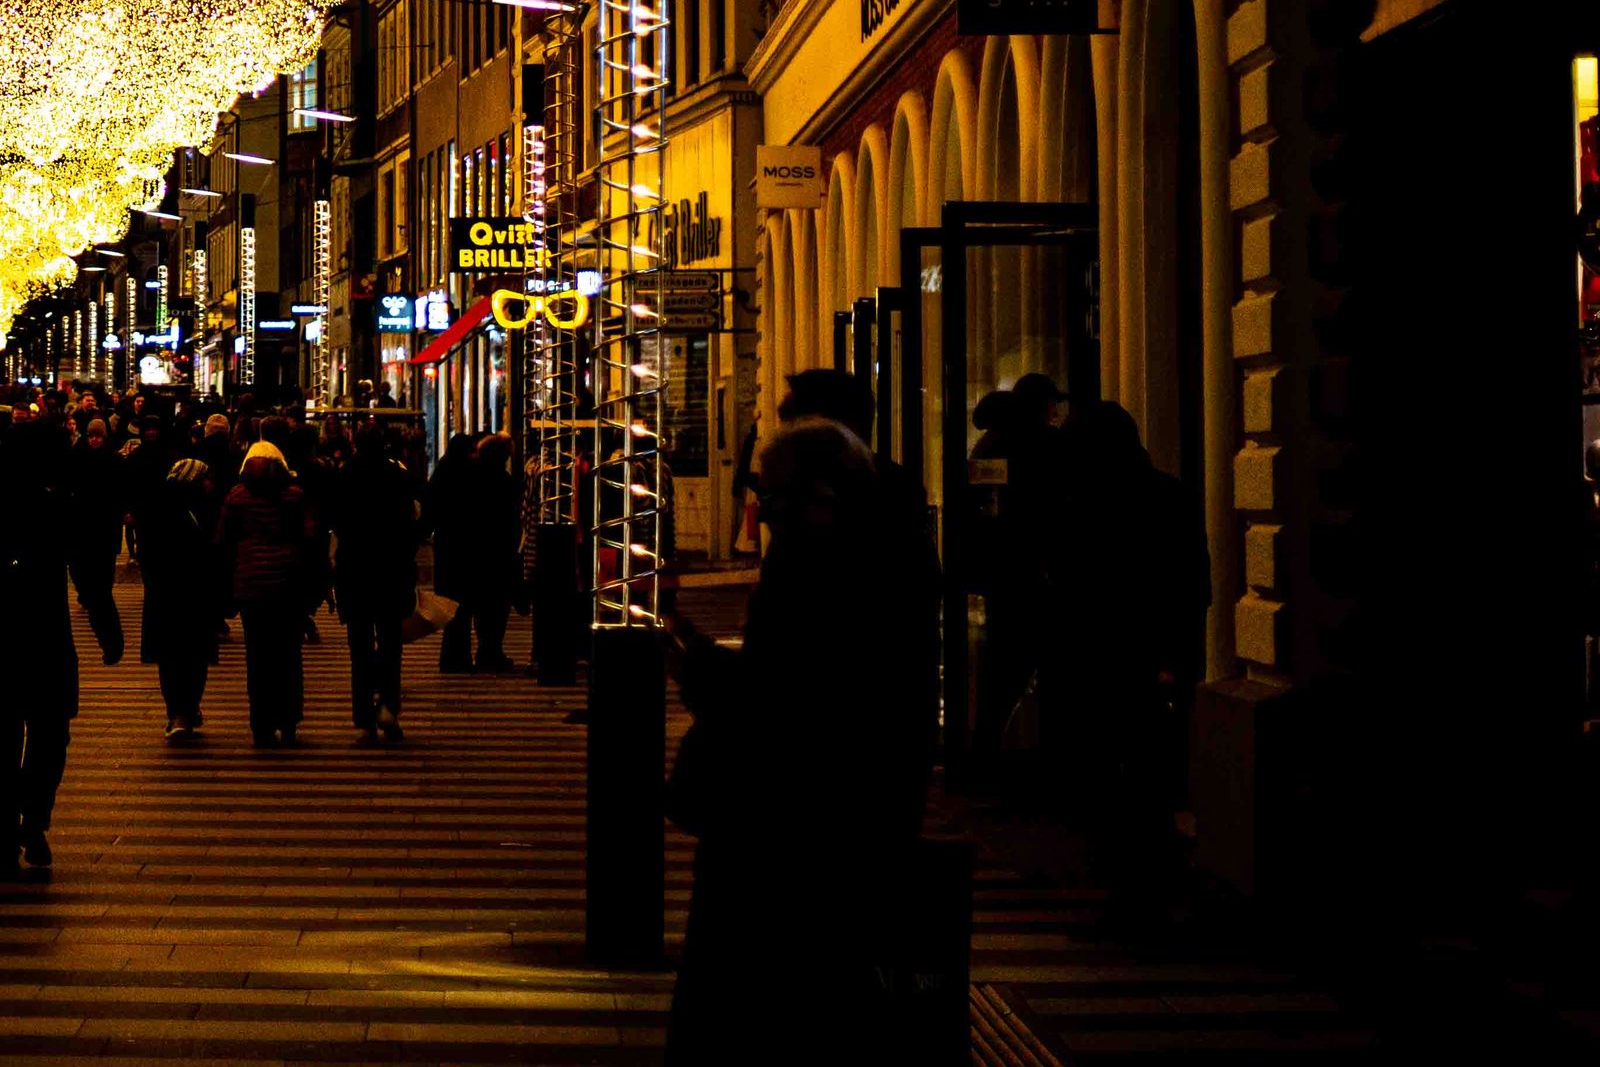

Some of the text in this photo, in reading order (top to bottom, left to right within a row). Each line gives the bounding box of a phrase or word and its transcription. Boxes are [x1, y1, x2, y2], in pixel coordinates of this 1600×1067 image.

[764, 166, 815, 179] MOSS
[469, 222, 535, 246] Qvist
[459, 249, 552, 268] BRILLER
